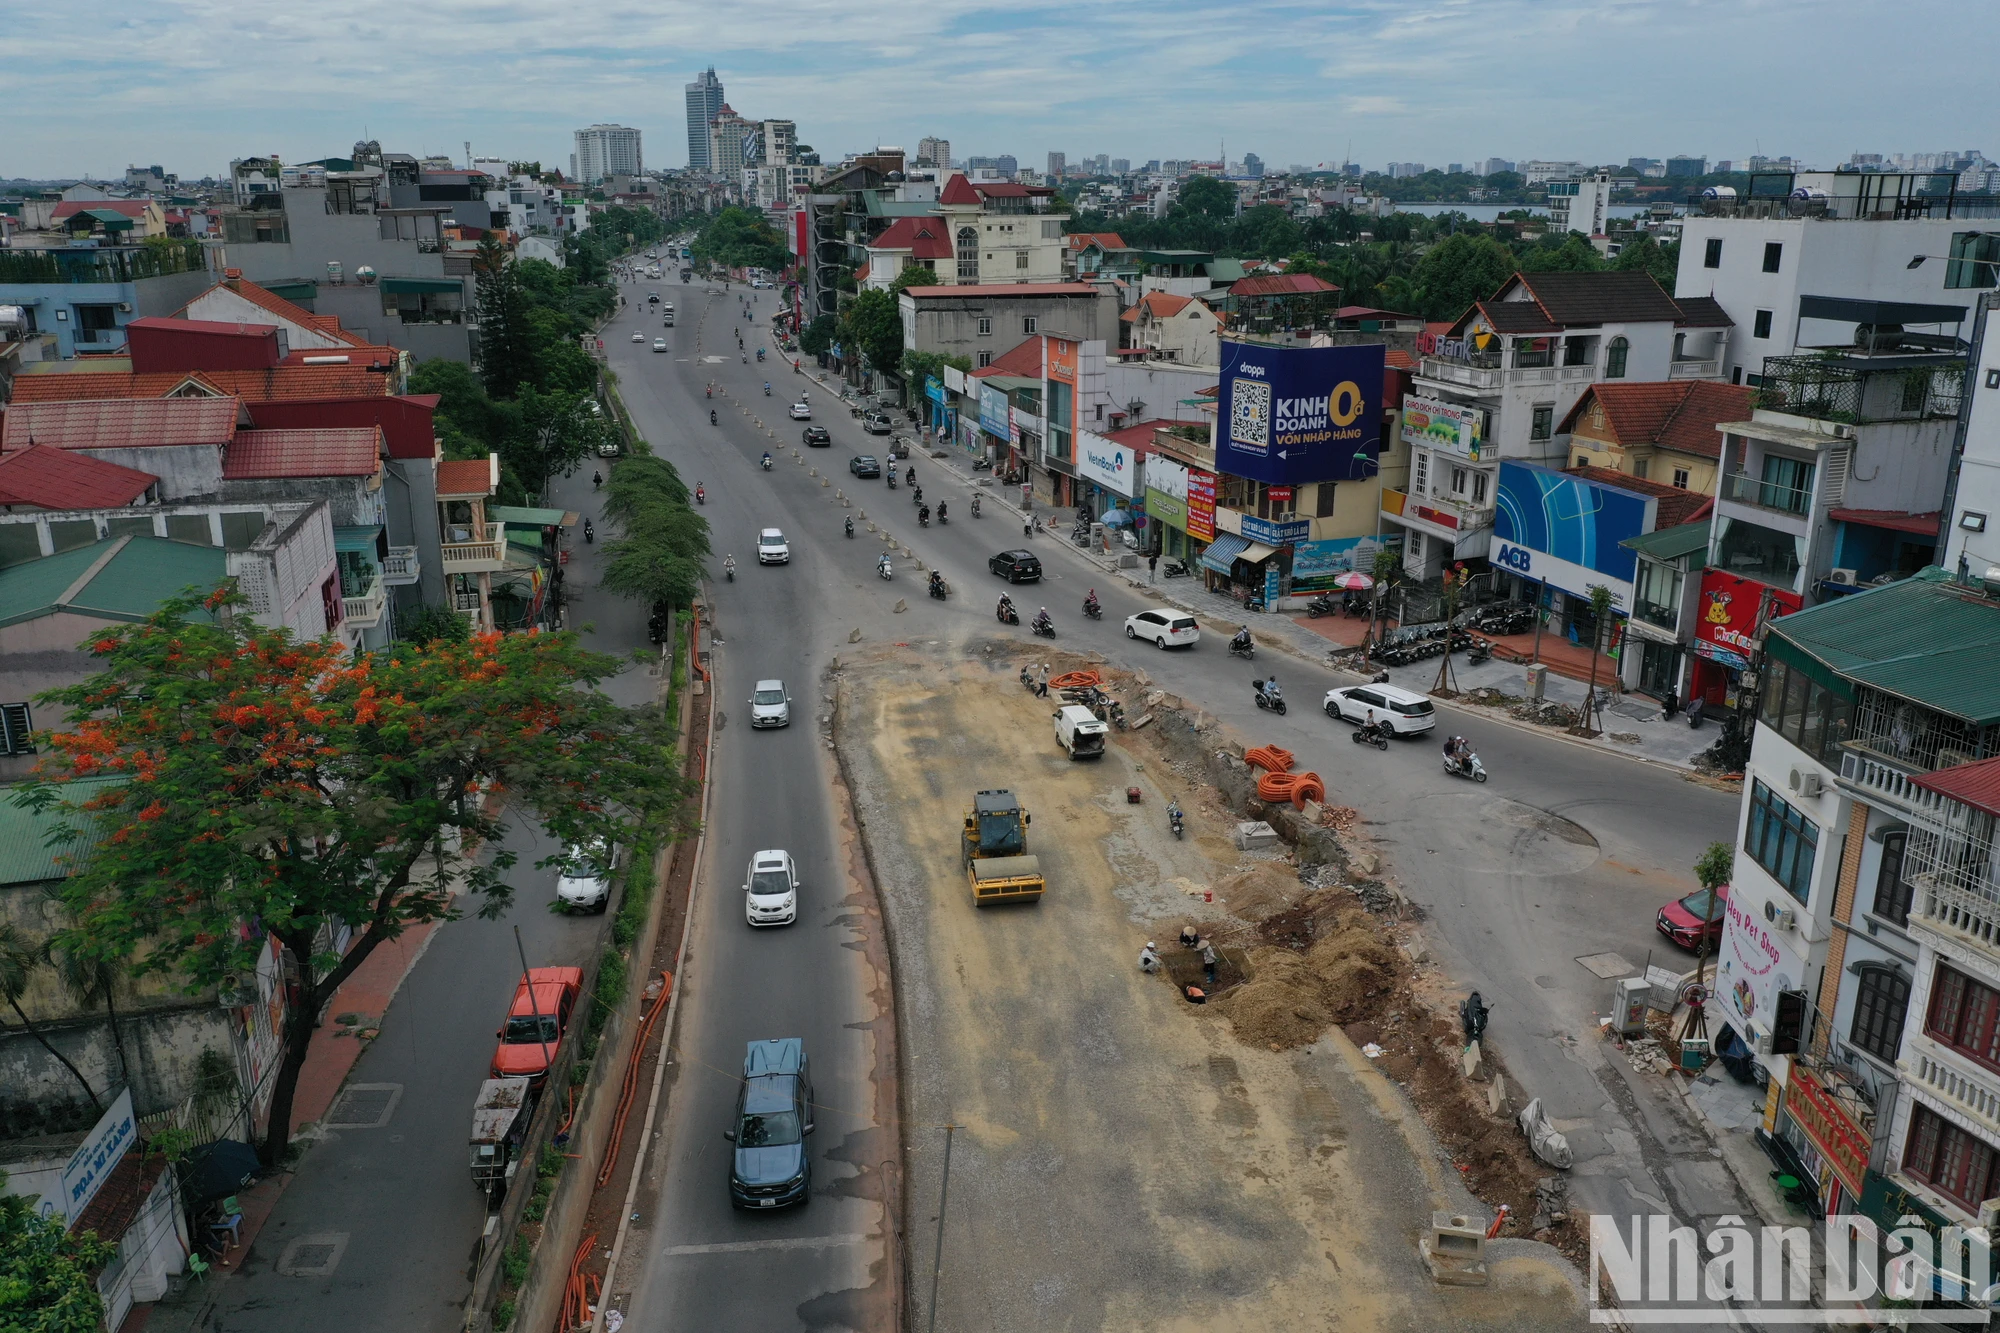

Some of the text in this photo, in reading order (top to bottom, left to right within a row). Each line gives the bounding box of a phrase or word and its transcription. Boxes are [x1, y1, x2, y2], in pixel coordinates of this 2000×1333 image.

[1416, 331, 1472, 360] HDBank
[1276, 396, 1329, 417] KINH
[1441, 408, 1460, 420] TRONG
[1275, 416, 1327, 431] DOANH
[1275, 428, 1362, 445] VỐN NHẬP HÀNG
[1087, 450, 1116, 473] VietinBank
[1497, 544, 1531, 572] ACB
[1727, 897, 1742, 927] Hey
[1744, 913, 1758, 941] Pet
[1760, 931, 1780, 966] Shop
